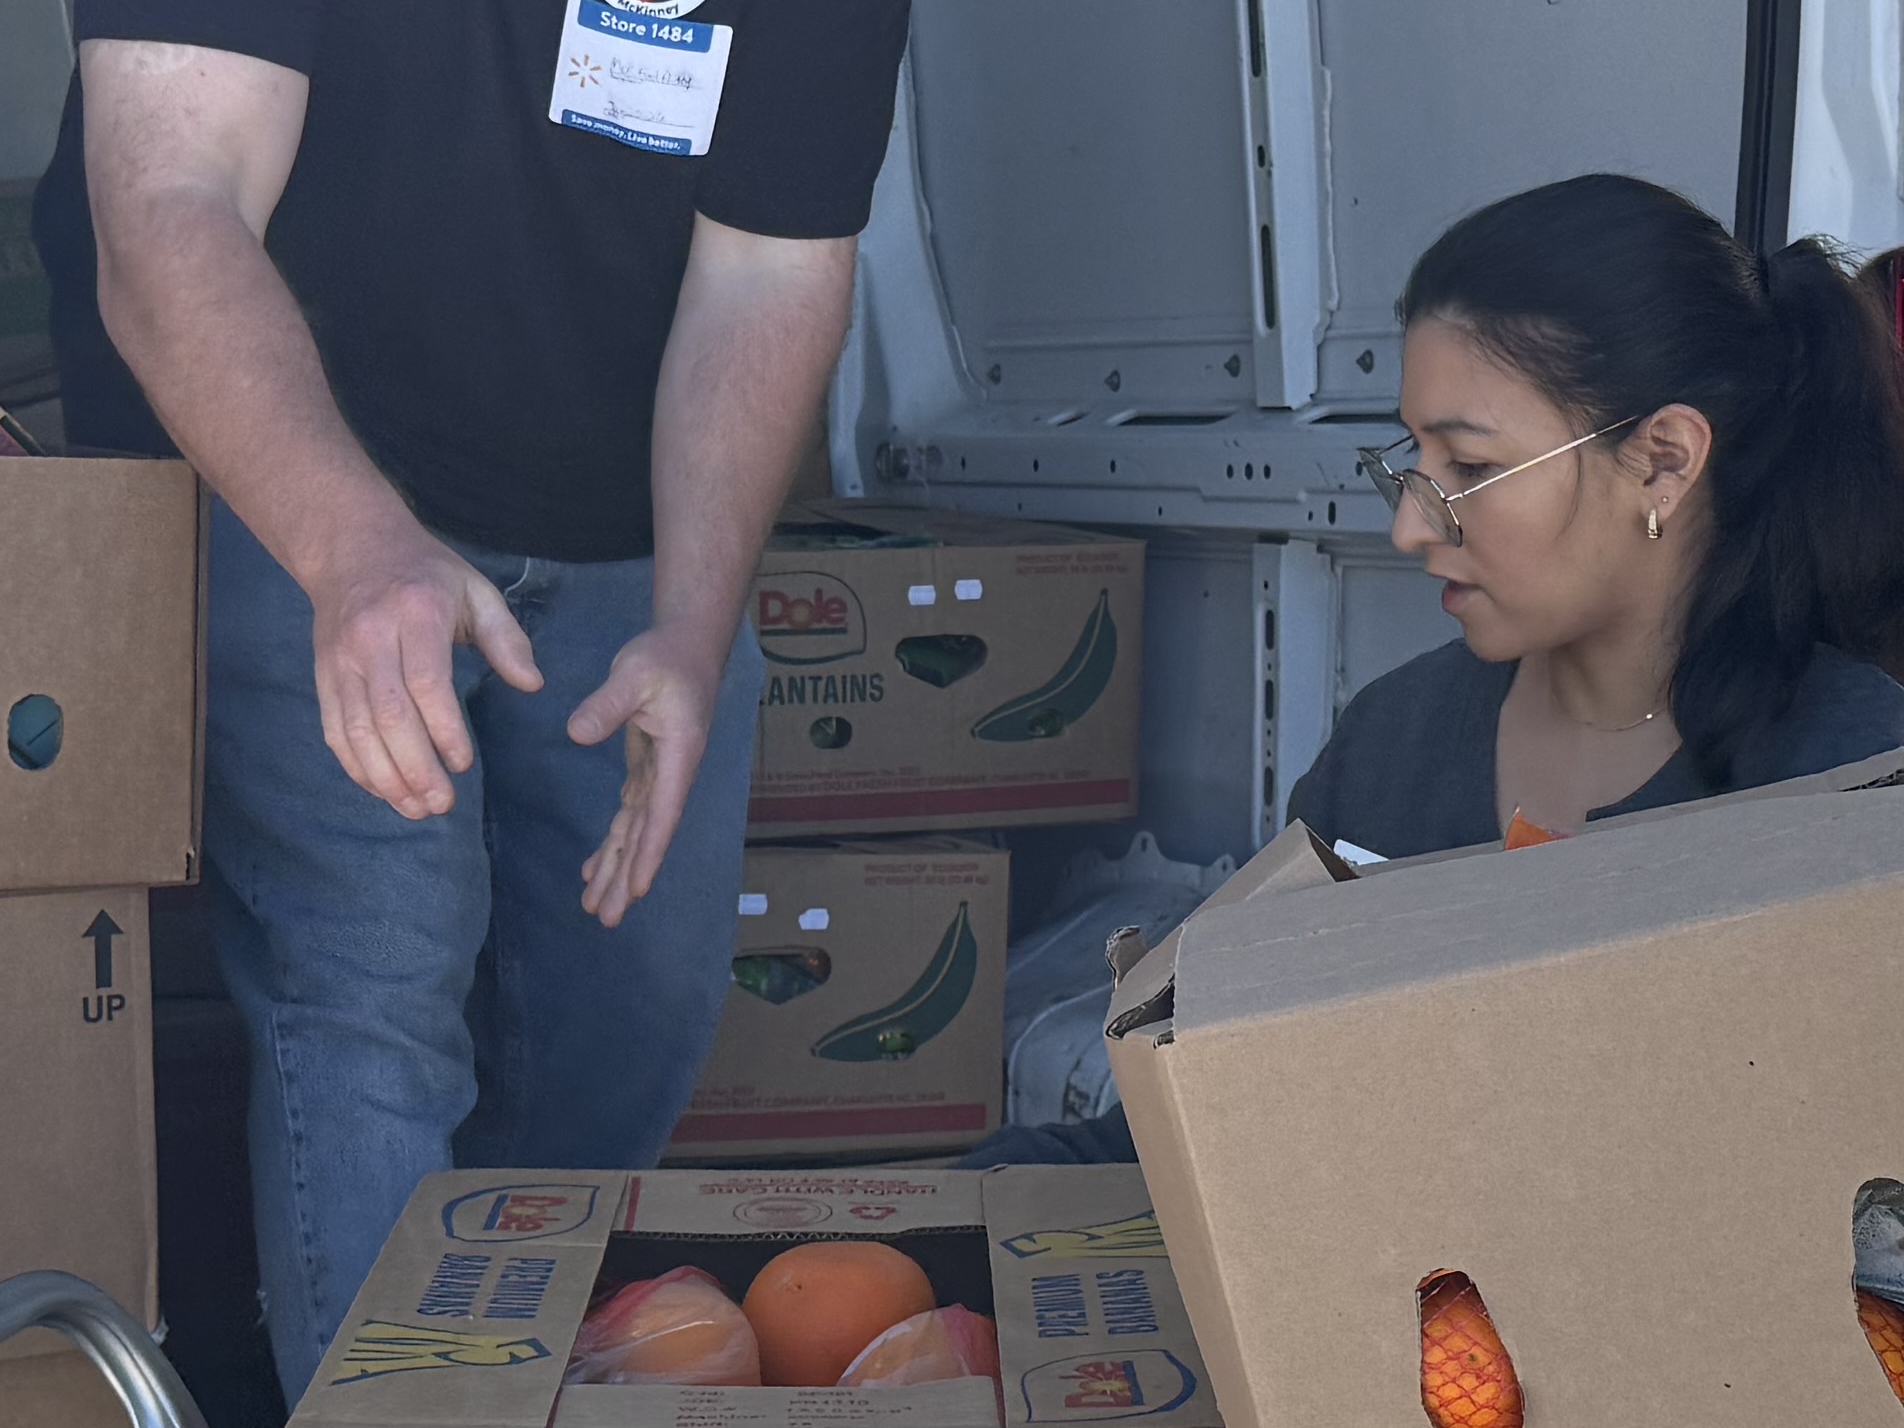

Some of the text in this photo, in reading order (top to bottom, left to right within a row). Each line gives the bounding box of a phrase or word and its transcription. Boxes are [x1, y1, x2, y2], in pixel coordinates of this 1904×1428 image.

[600, 11, 695, 44] Store 1484
[758, 587, 848, 630] Dole
[759, 673, 885, 707] ANTAINS
[81, 993, 128, 1025] UP
[495, 1195, 569, 1233] Dole
[1031, 1273, 1090, 1338] PREMIUM
[1096, 1269, 1160, 1335] BANANAS
[1058, 1360, 1132, 1409] Dole
